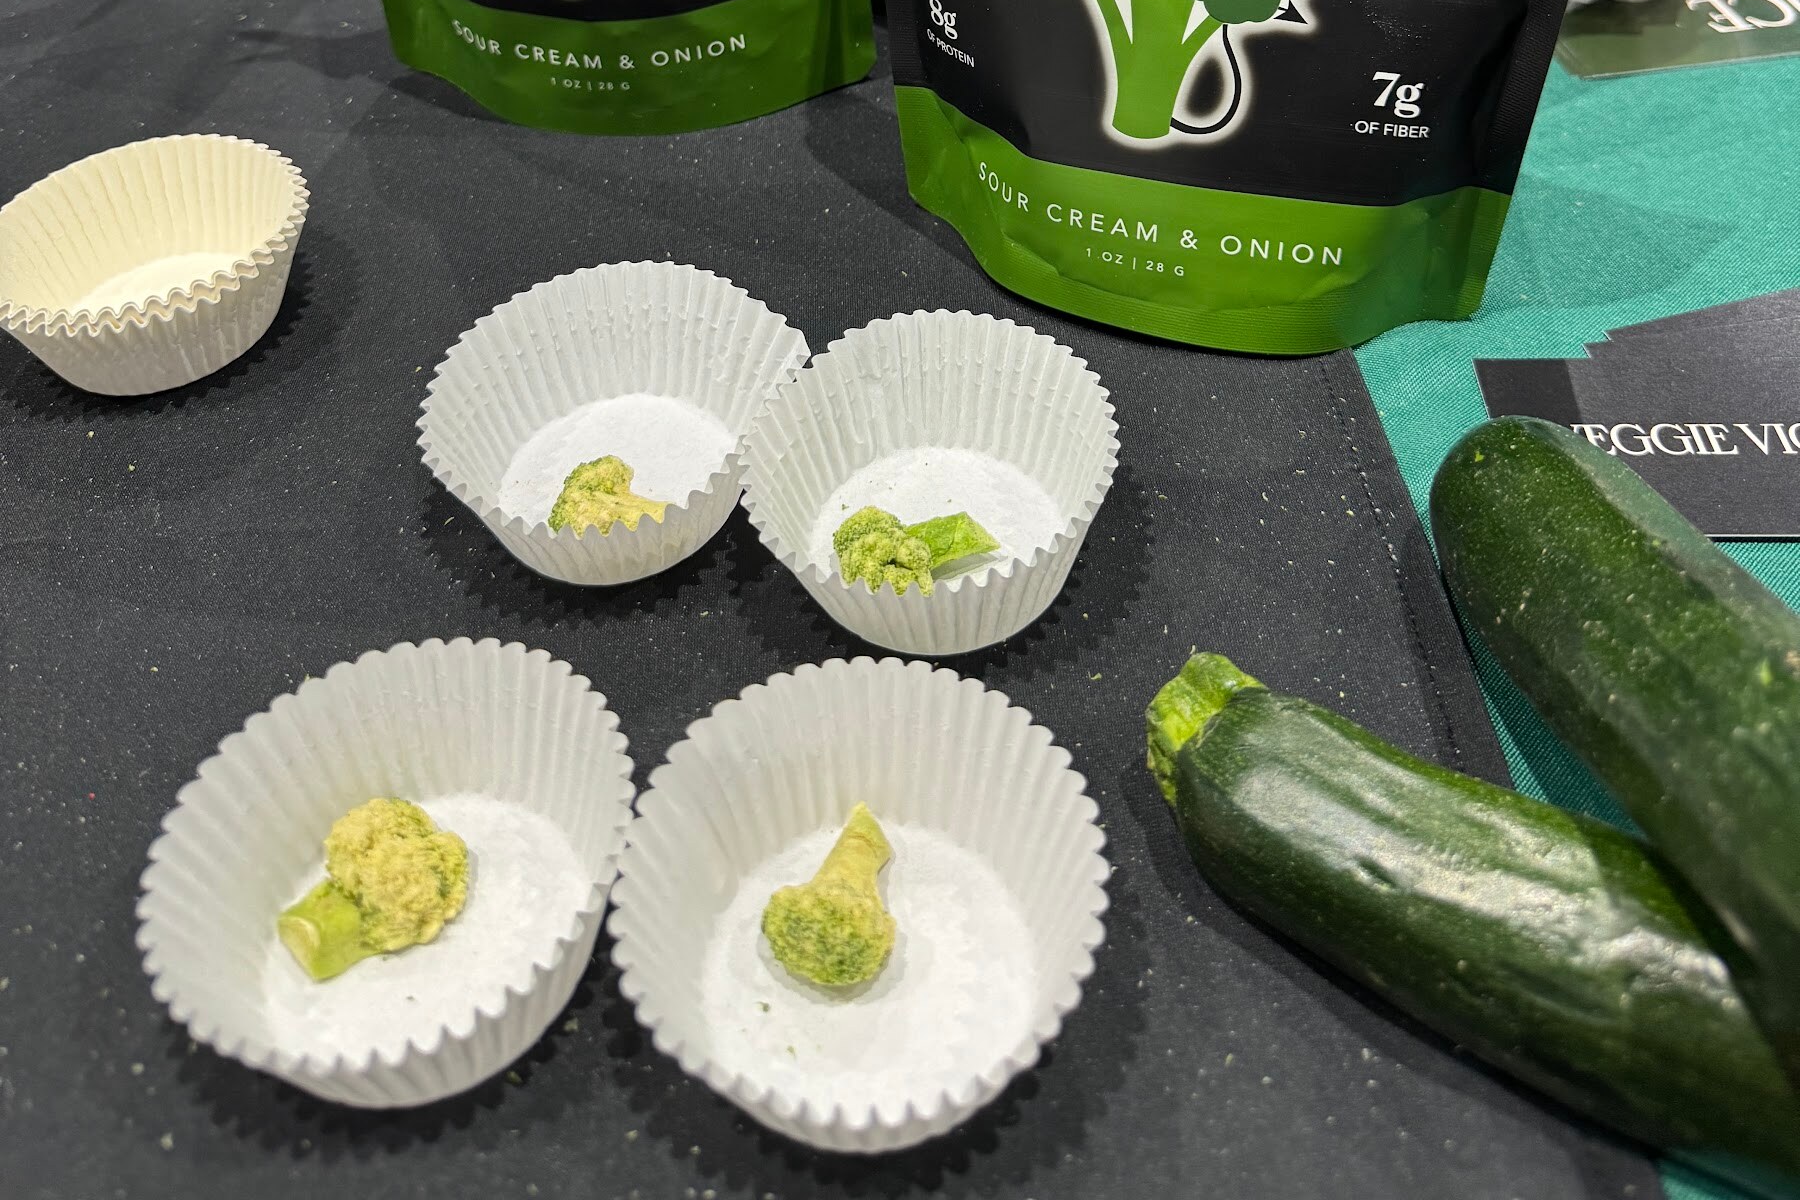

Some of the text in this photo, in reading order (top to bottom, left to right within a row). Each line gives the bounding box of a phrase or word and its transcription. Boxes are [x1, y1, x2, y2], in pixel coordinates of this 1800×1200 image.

[452, 20, 745, 69] SOUR CREAM & ONION
[936, 37, 976, 69] PROTEIN
[564, 79, 582, 89] OZ
[599, 81, 614, 91] 28
[621, 81, 631, 91] G
[1370, 72, 1425, 119] 7g
[1355, 121, 1430, 139] OF FIBER
[979, 162, 1342, 265] SOUR CREAM & ONION
[1086, 247, 1091, 258] 1
[1101, 251, 1124, 265] OZ
[1145, 260, 1164, 273] 28
[1174, 265, 1185, 277] G
